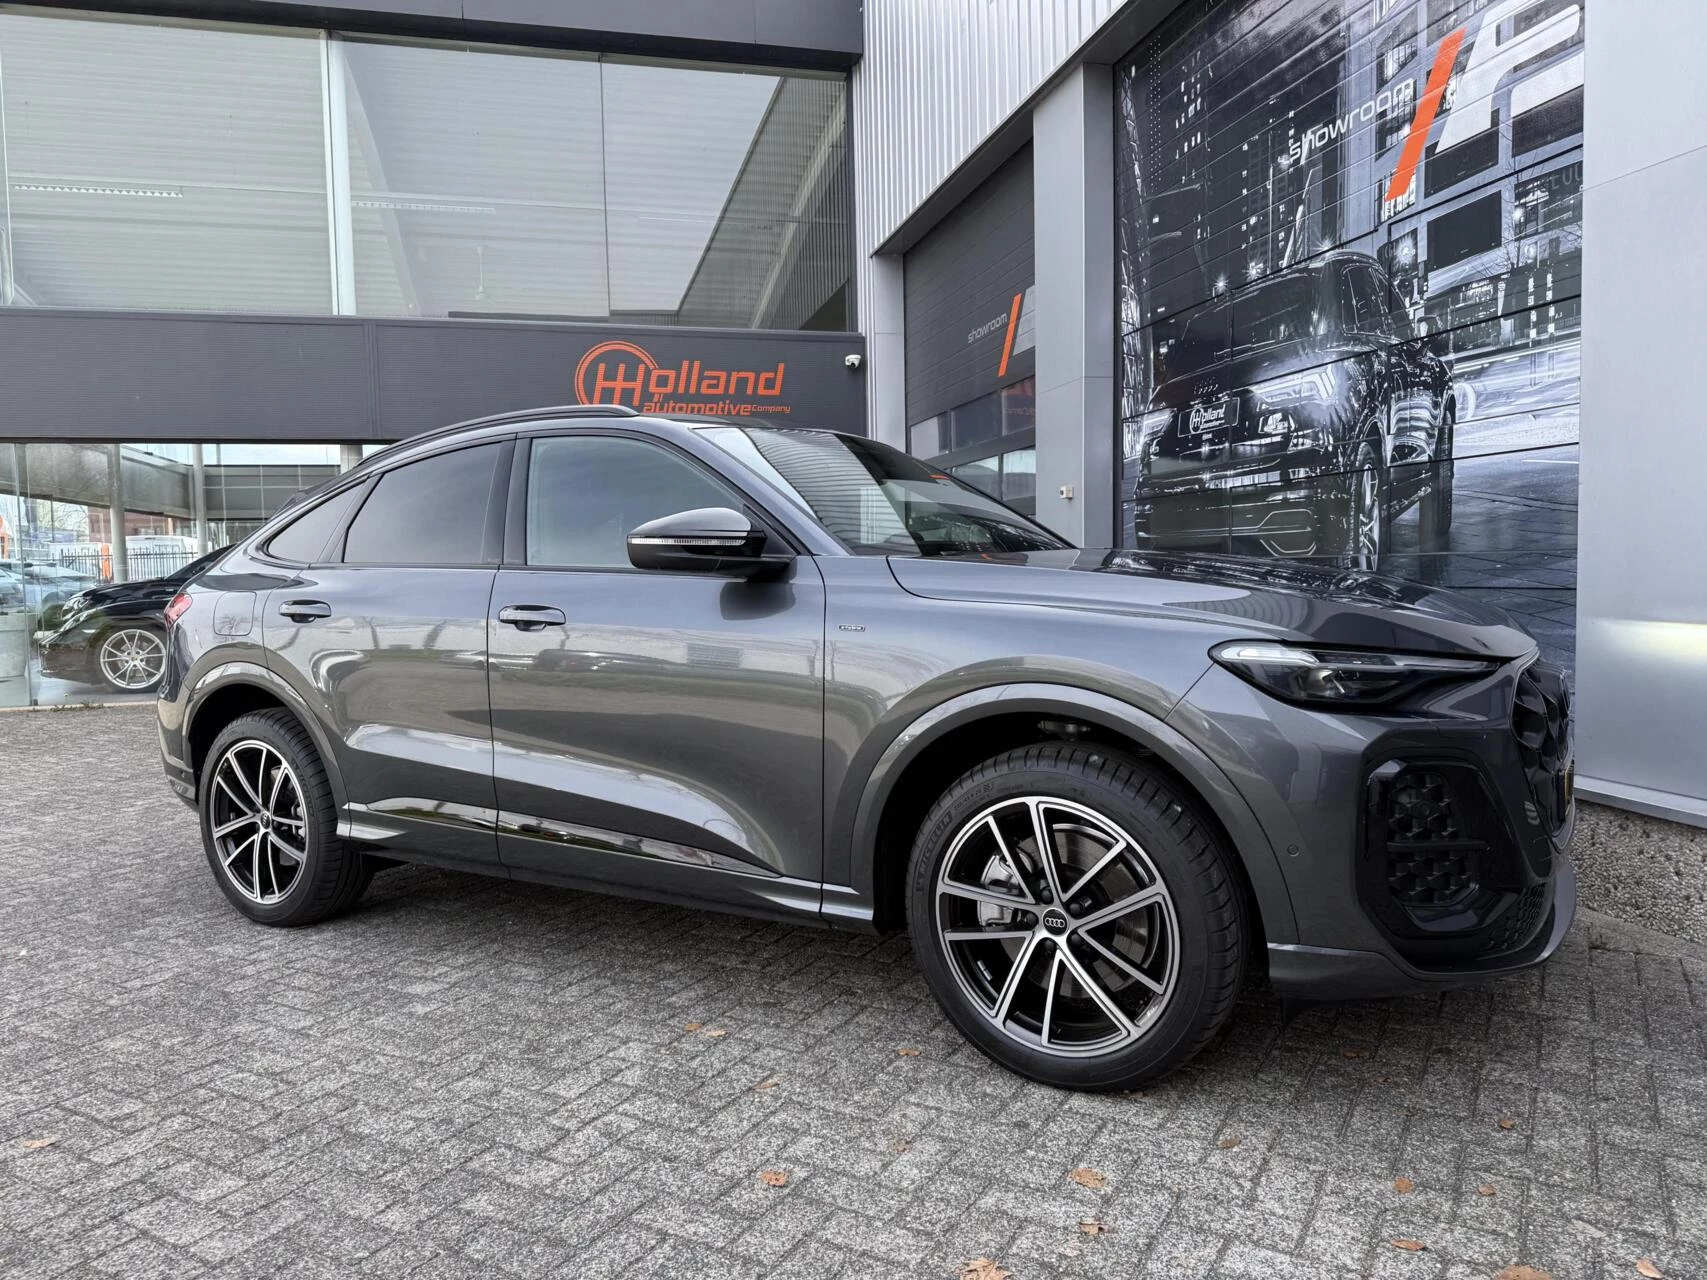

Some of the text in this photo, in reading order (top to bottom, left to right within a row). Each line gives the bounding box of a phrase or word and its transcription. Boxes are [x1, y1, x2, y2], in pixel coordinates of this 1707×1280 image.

[1289, 78, 1414, 161] showroom
[967, 313, 1008, 344] showroom
[643, 400, 791, 416] automotive Company
